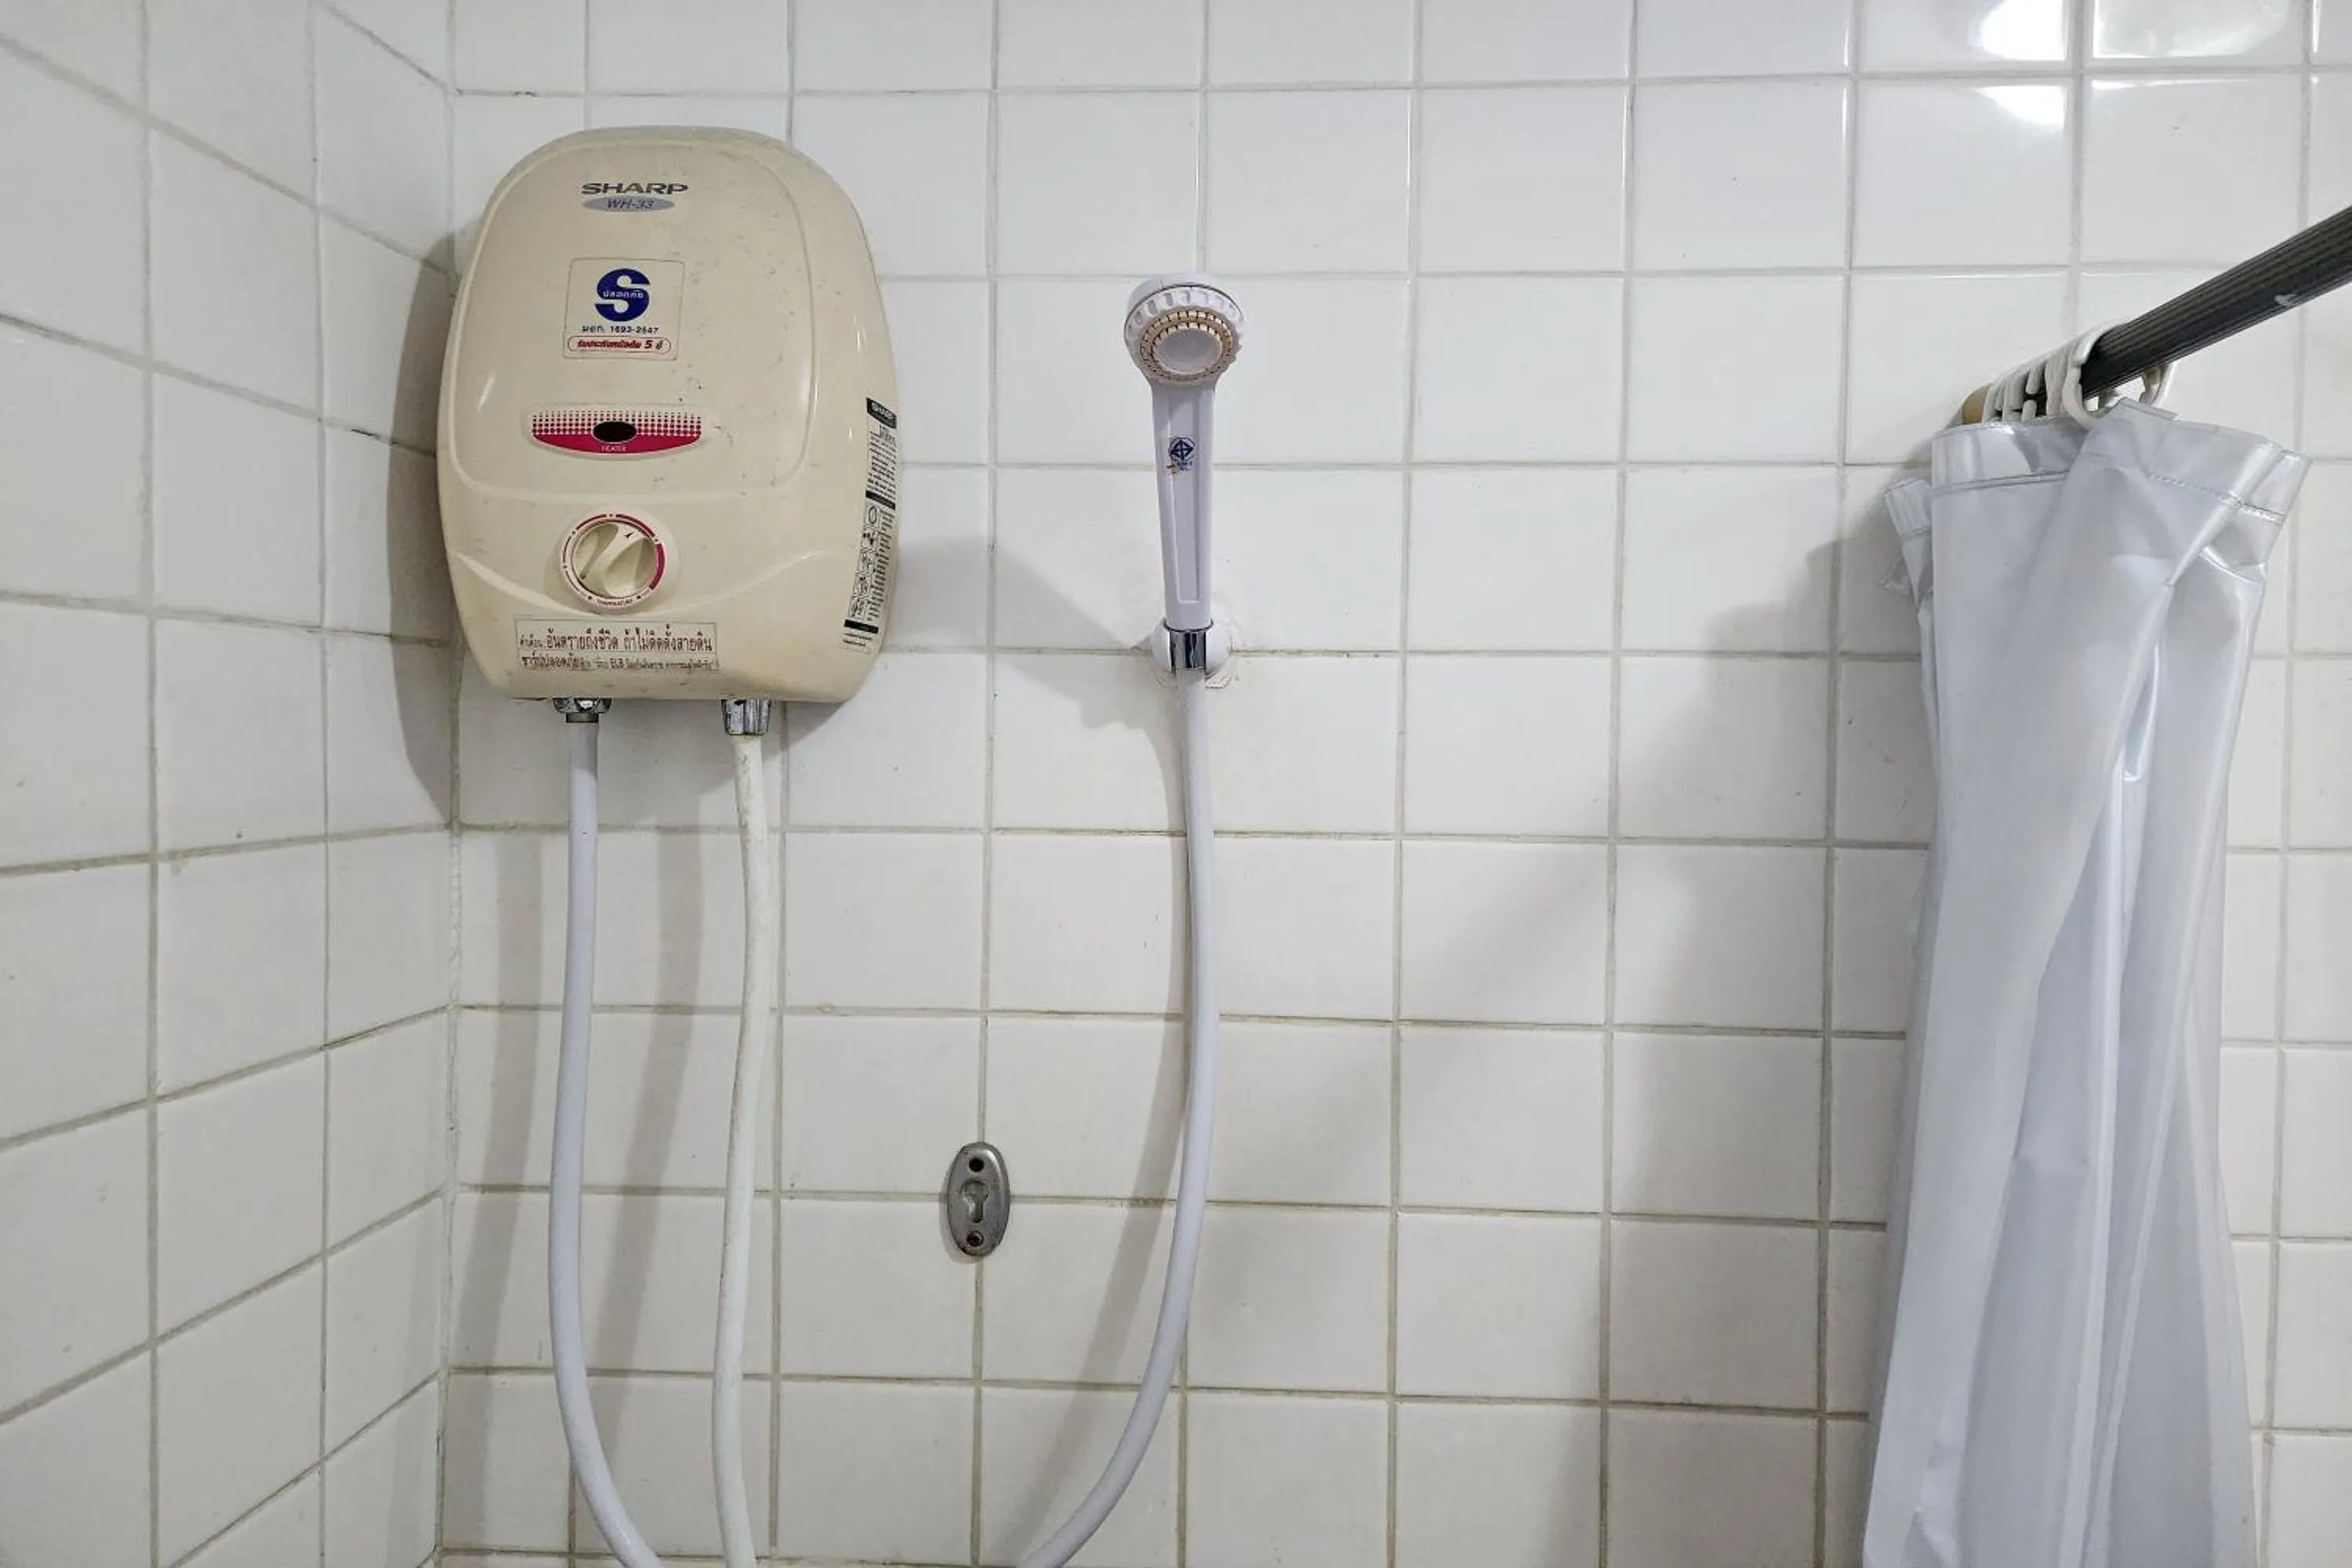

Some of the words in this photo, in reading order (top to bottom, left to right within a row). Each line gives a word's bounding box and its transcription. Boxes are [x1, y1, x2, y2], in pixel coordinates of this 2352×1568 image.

[581, 183, 688, 194] SHARP
[608, 198, 654, 209] WH-33
[644, 339, 653, 349] 5
